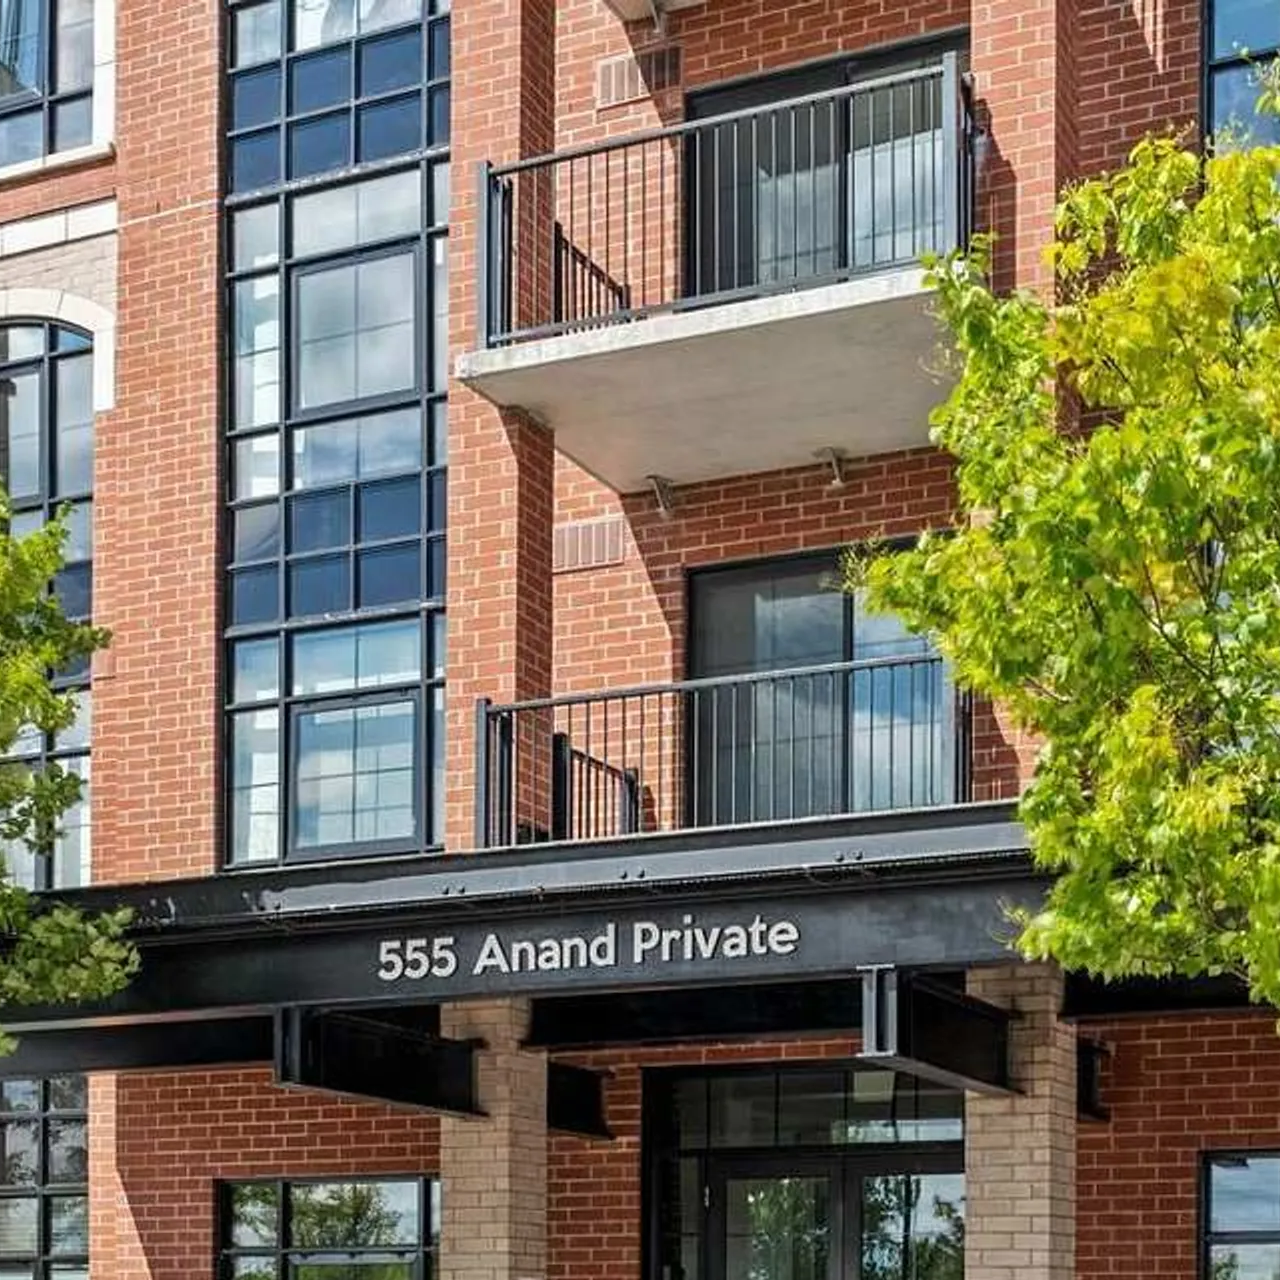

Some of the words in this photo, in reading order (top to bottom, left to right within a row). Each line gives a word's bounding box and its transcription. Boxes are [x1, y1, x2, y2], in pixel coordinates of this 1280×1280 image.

[378, 936, 457, 981] 555
[472, 923, 616, 976] Anand
[633, 914, 800, 964] Private
